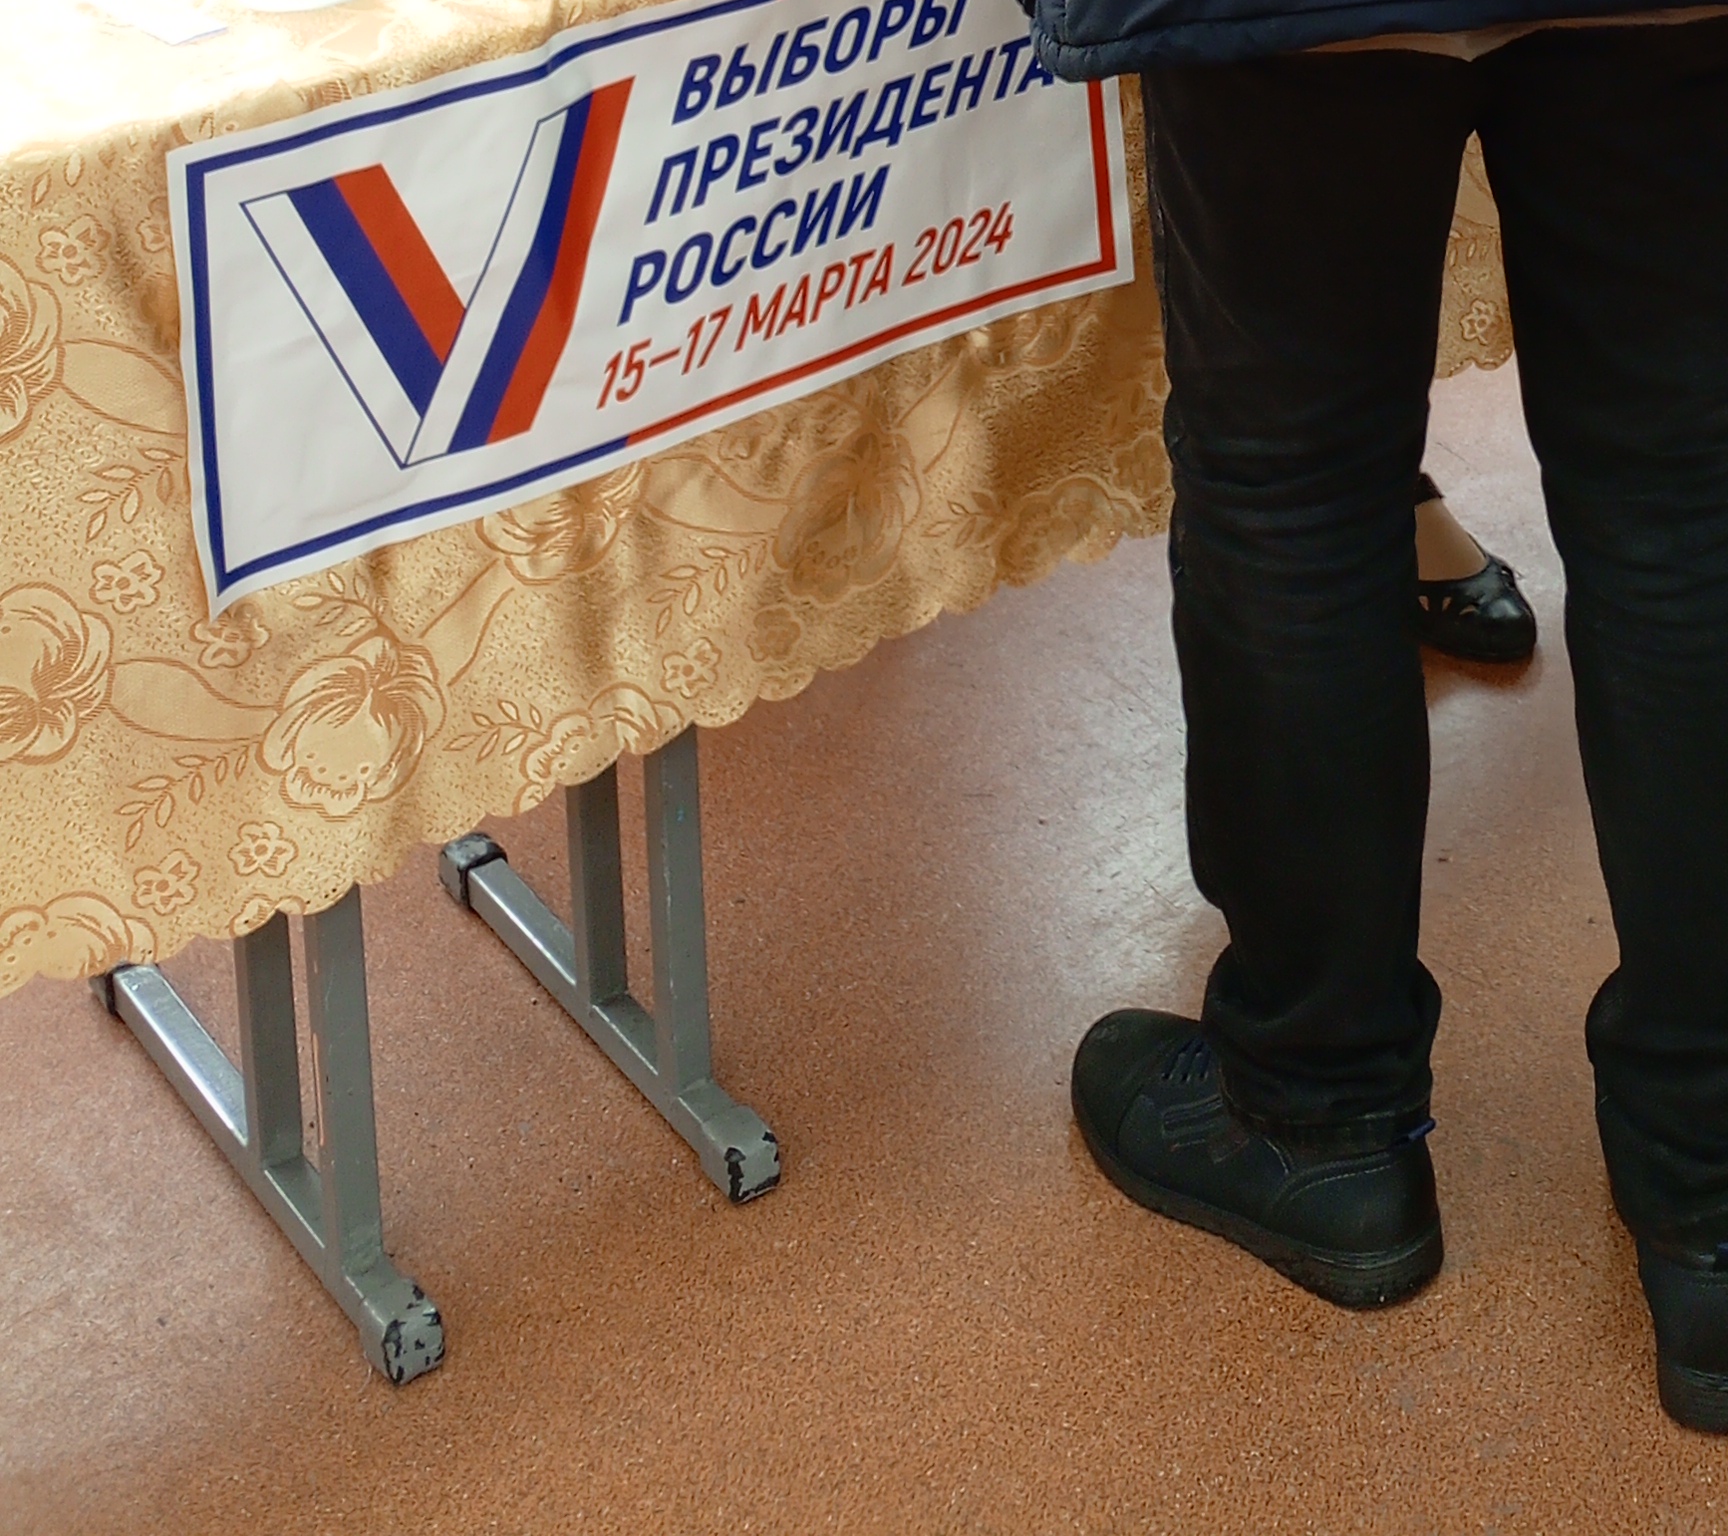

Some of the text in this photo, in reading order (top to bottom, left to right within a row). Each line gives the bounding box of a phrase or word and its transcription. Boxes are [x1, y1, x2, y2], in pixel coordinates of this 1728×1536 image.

[644, 35, 1054, 225] ПРЕЗИДЕНТА
[617, 164, 892, 326] РОССИИ
[734, 242, 895, 352] МАРТА
[901, 201, 1015, 288] 2024
